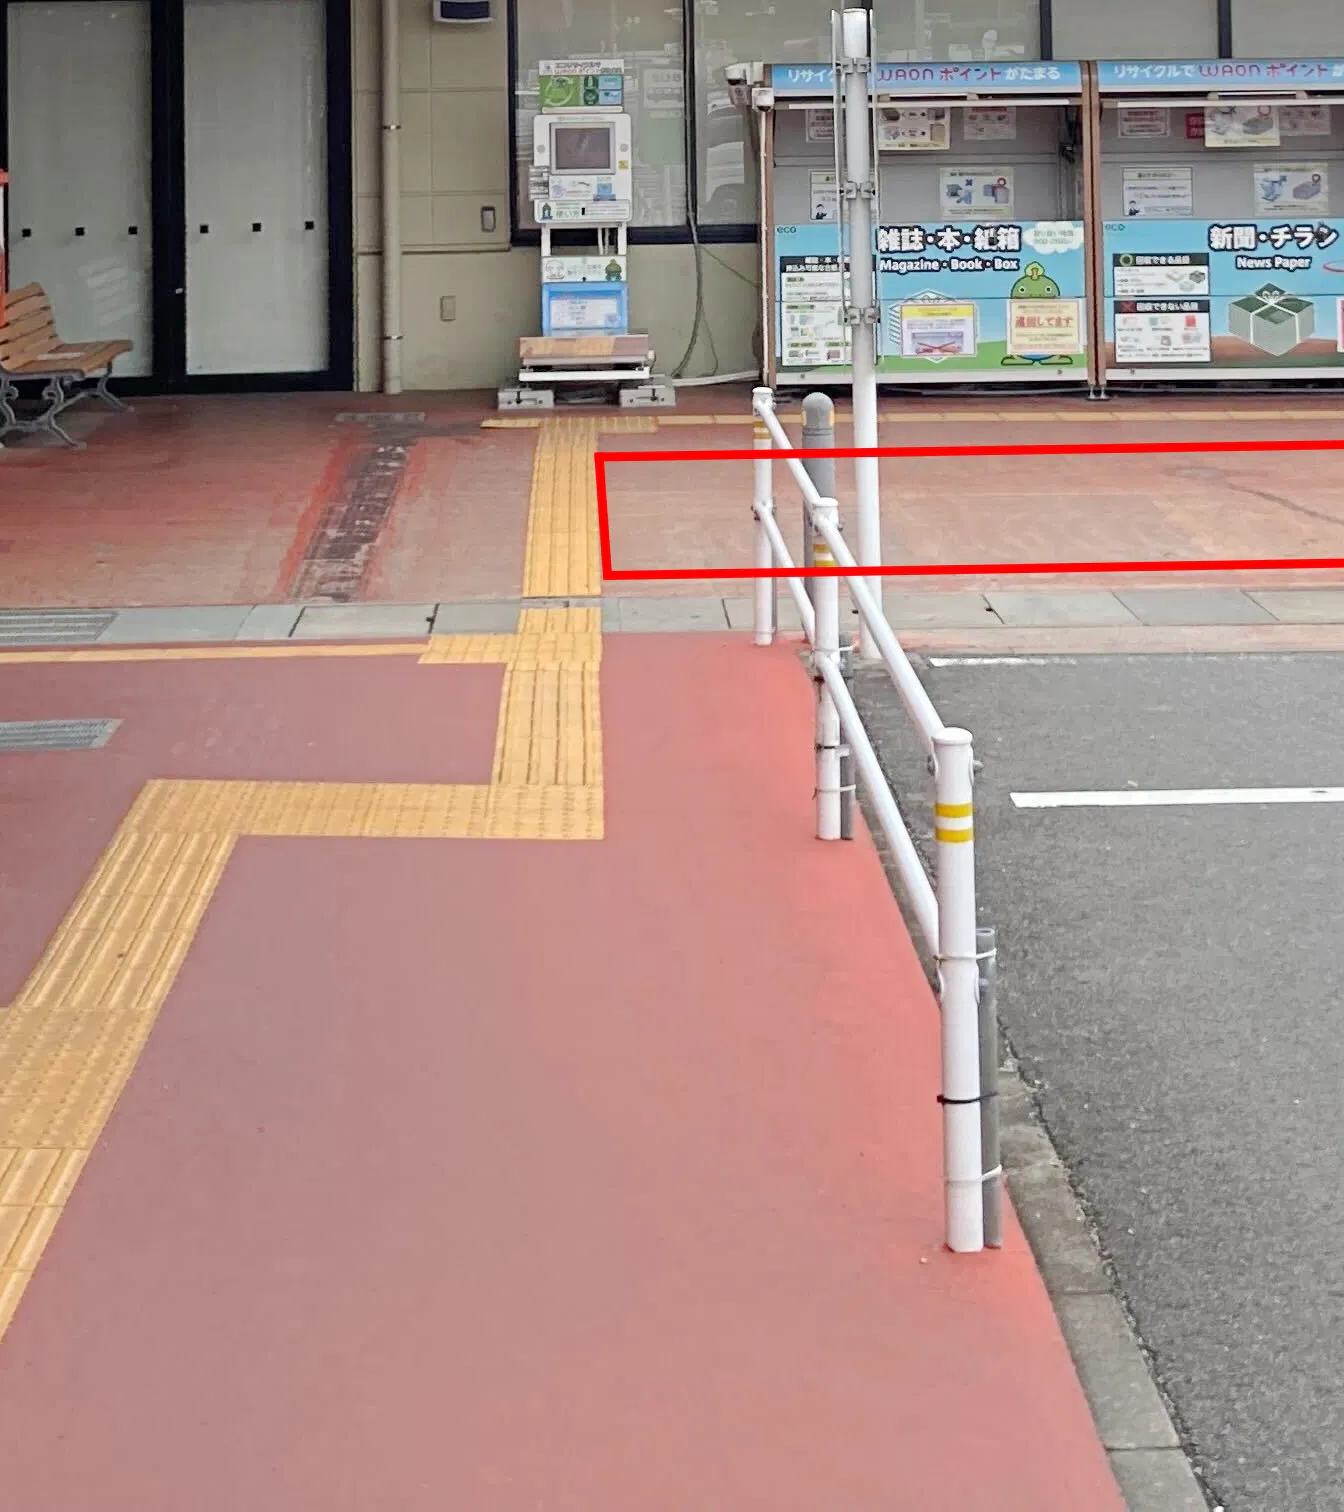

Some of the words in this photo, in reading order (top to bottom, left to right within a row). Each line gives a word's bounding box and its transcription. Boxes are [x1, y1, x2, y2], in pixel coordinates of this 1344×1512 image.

[939, 66, 1002, 81] ポイント
[1005, 66, 1061, 81] がたまる
[1113, 65, 1196, 78] リサイクルで
[1198, 64, 1261, 77] WAON
[1266, 64, 1328, 77] ポイント
[777, 226, 797, 234] eco
[1235, 255, 1272, 269] News
[1273, 256, 1313, 271] Paper
